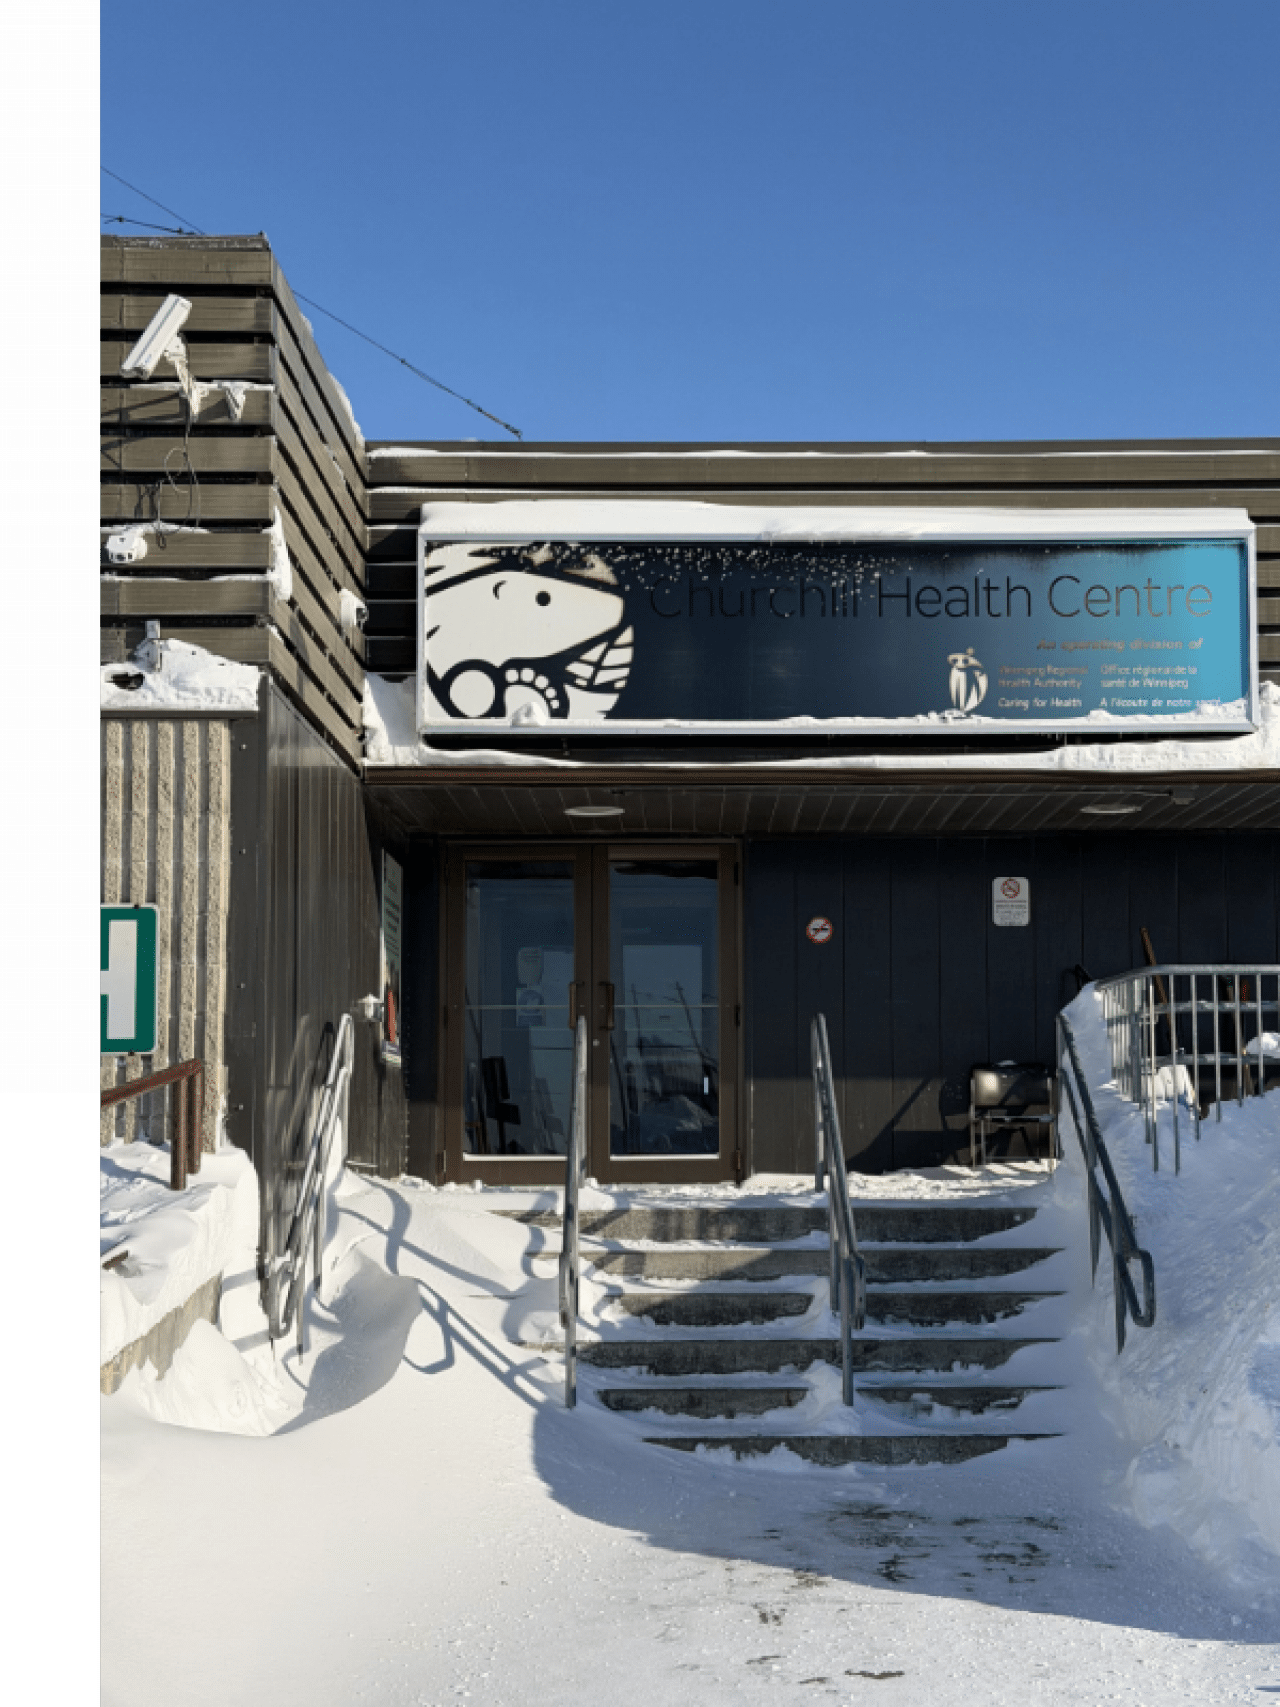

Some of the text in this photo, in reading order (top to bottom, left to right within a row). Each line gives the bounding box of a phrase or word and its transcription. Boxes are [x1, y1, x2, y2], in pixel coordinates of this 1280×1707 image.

[650, 574, 1213, 618] Churchill Health Centre
[1036, 636, 1204, 652] An operating division of
[1100, 663, 1131, 675] Office
[1034, 677, 1083, 689] Authority
[1142, 676, 1189, 690] Winnipeg
[998, 697, 1083, 711] Caring for Health
